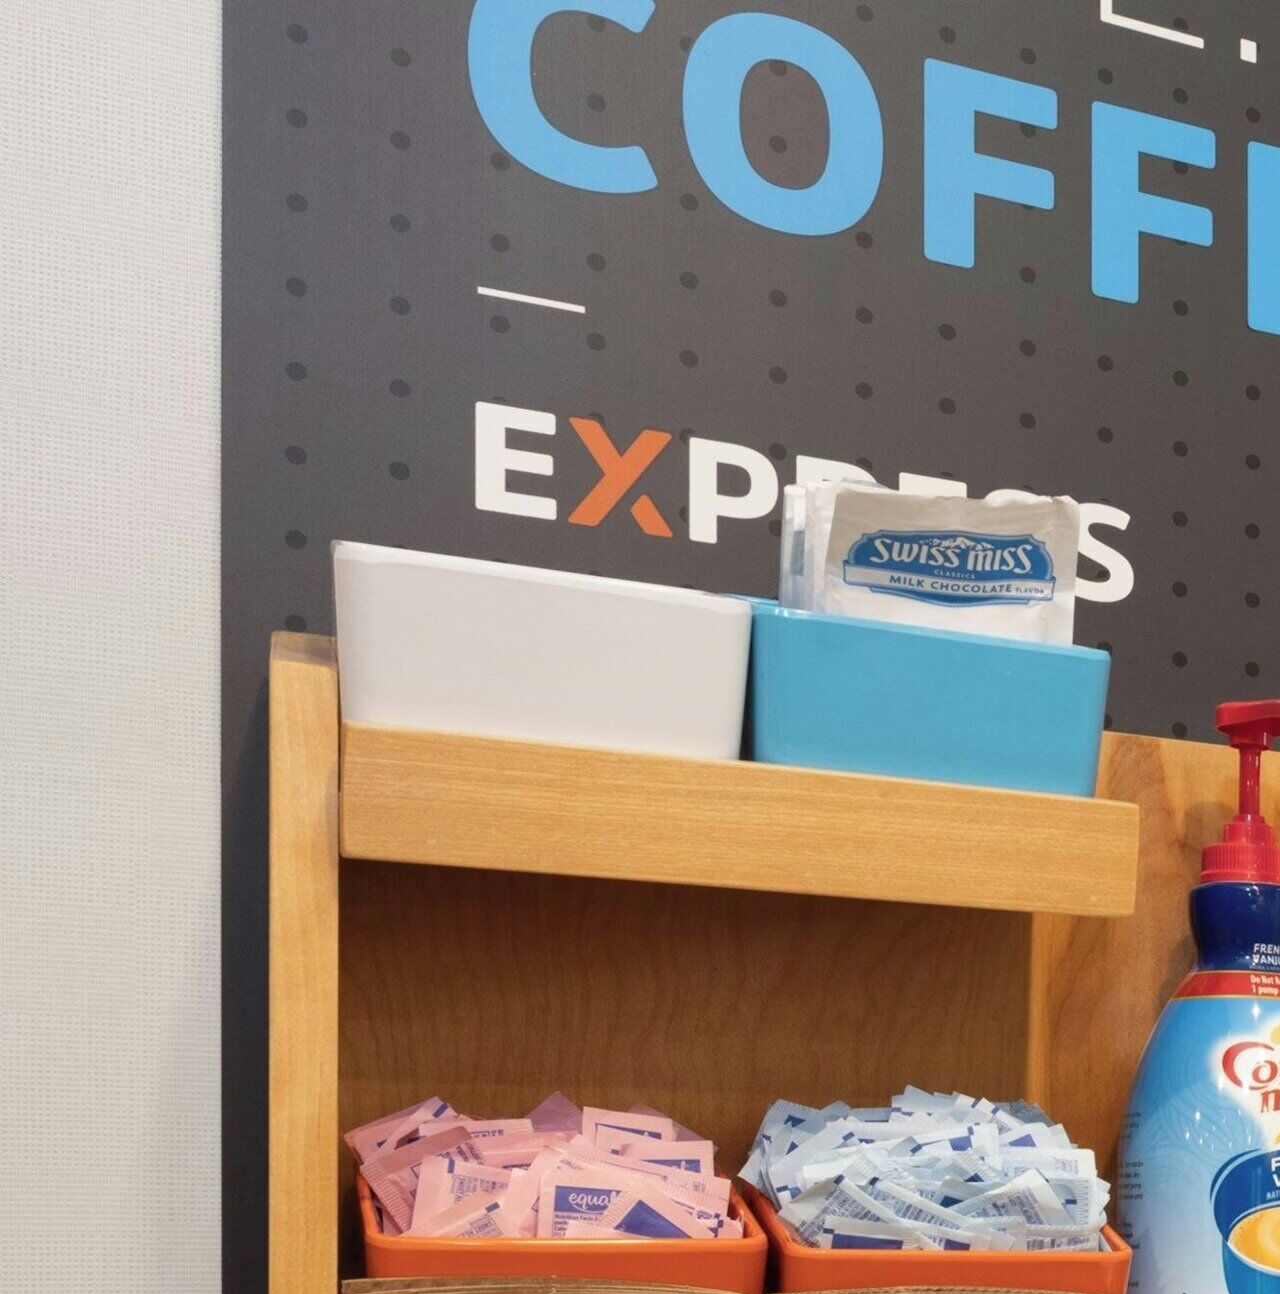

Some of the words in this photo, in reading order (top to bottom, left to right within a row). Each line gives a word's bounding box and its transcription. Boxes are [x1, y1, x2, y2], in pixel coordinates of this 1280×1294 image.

[475, 401, 1134, 602] EXPS
[934, 569, 975, 580] CLASSICS
[889, 575, 925, 589] MILK
[931, 580, 1013, 594] CHOCOLATE
[1250, 974, 1261, 984] Do
